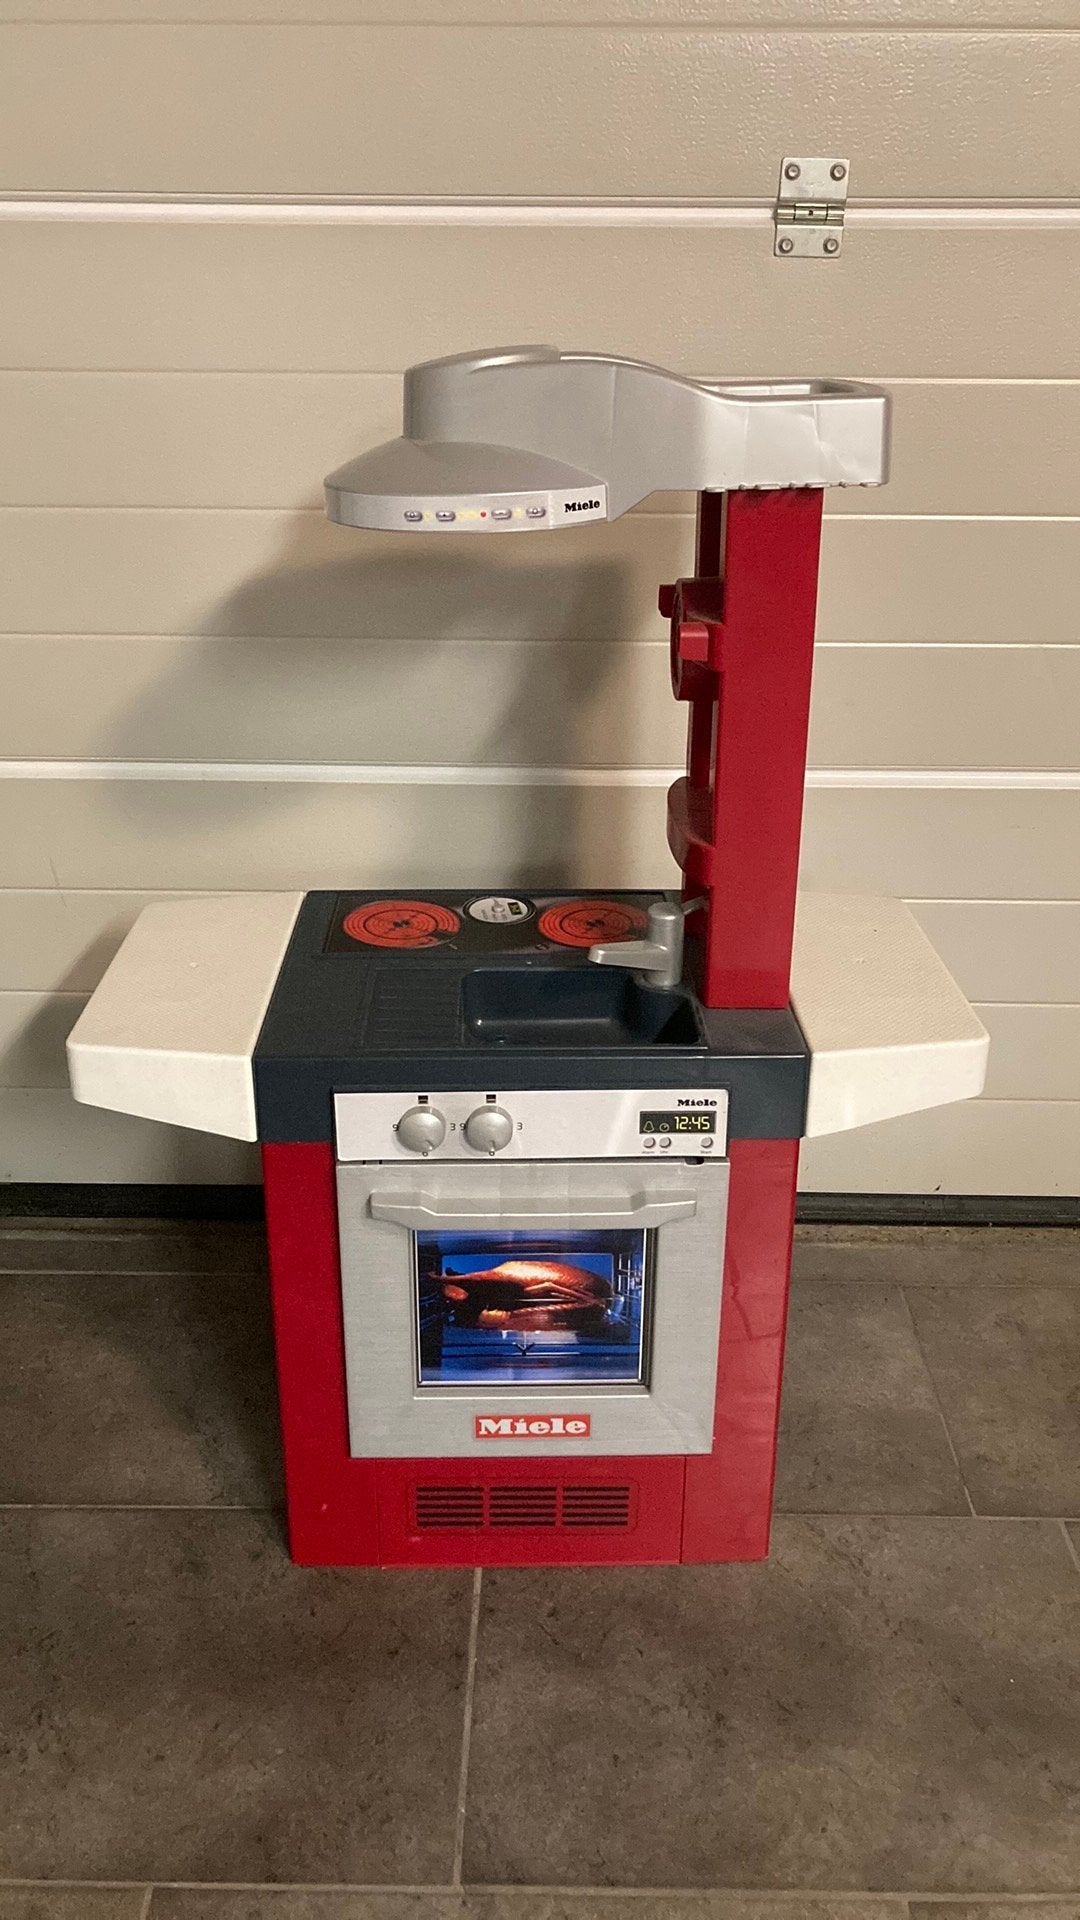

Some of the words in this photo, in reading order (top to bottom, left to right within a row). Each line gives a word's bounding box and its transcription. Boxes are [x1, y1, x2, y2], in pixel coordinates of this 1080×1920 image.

[564, 500, 600, 513] Miele
[677, 1099, 718, 1107] Miele
[449, 1122, 457, 1131] 3
[516, 1121, 524, 1131] 3
[674, 1116, 710, 1130] 12:45
[478, 1417, 588, 1435] Miele
